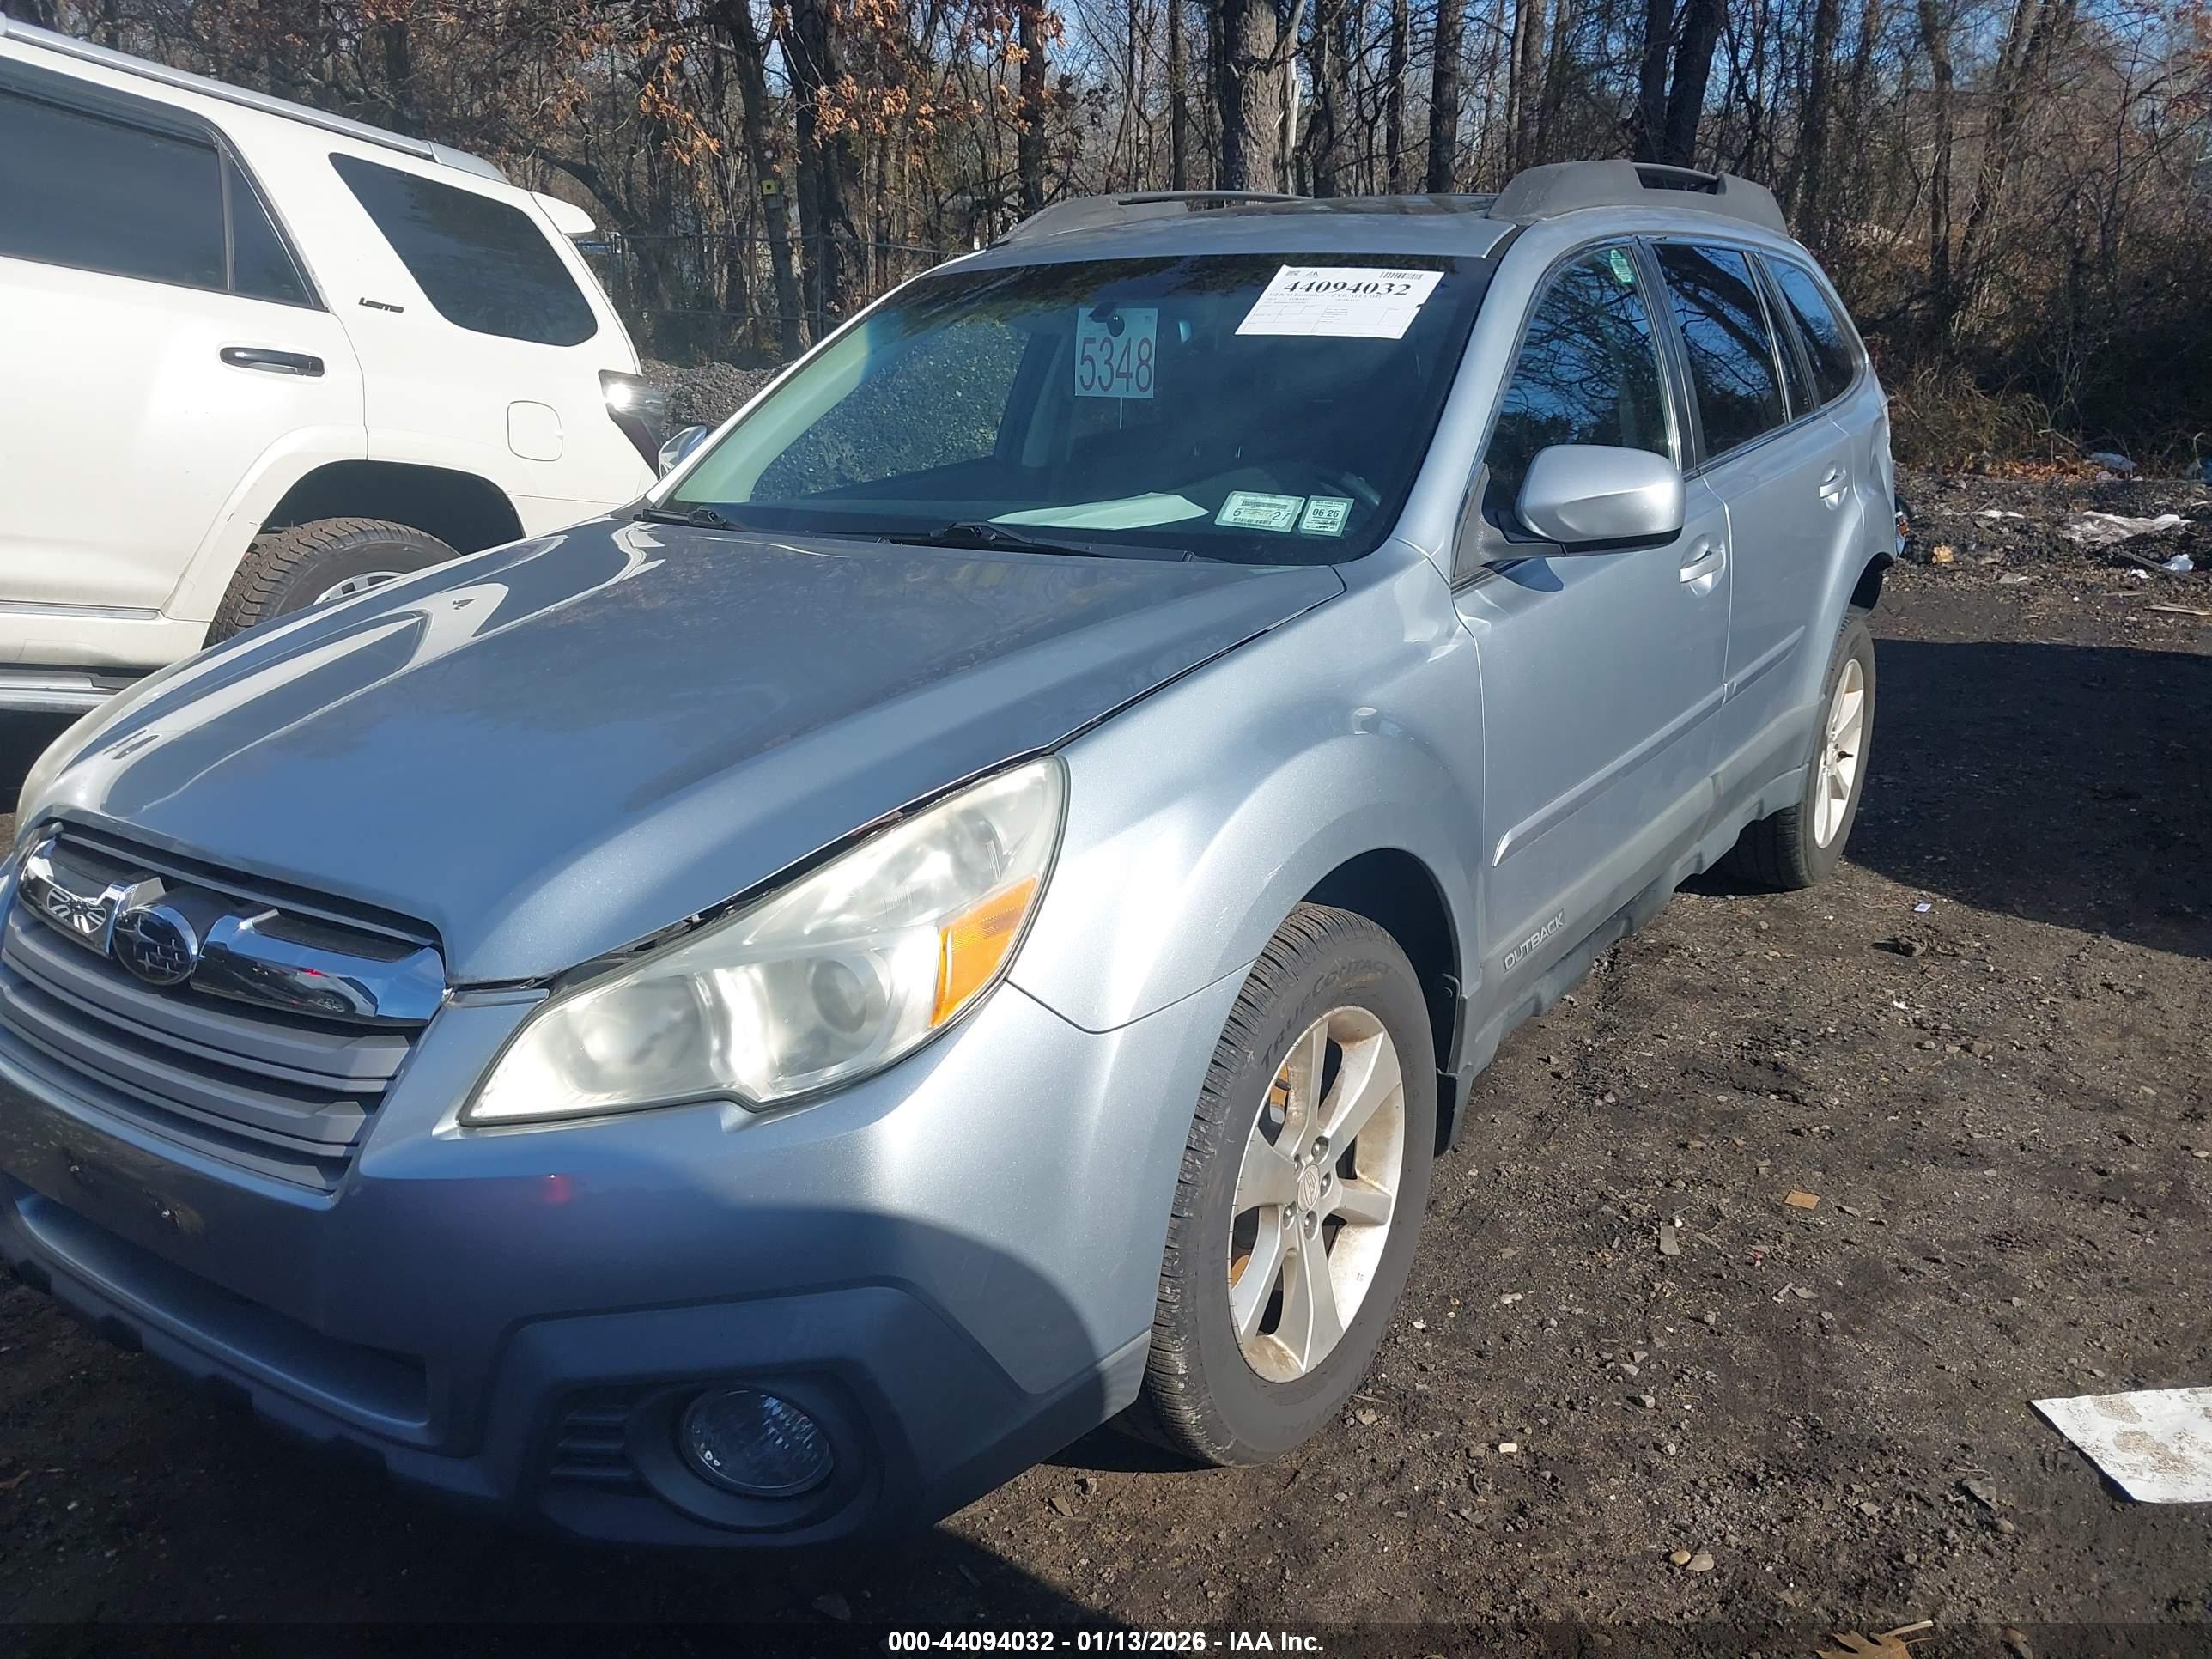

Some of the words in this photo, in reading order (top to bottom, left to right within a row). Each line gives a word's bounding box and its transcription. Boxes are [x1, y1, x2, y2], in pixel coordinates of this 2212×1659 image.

[1284, 281, 1412, 296] 44094032
[1079, 337, 1152, 393] 5348
[1272, 511, 1291, 521] 27
[1504, 911, 1564, 970] OUTBACK
